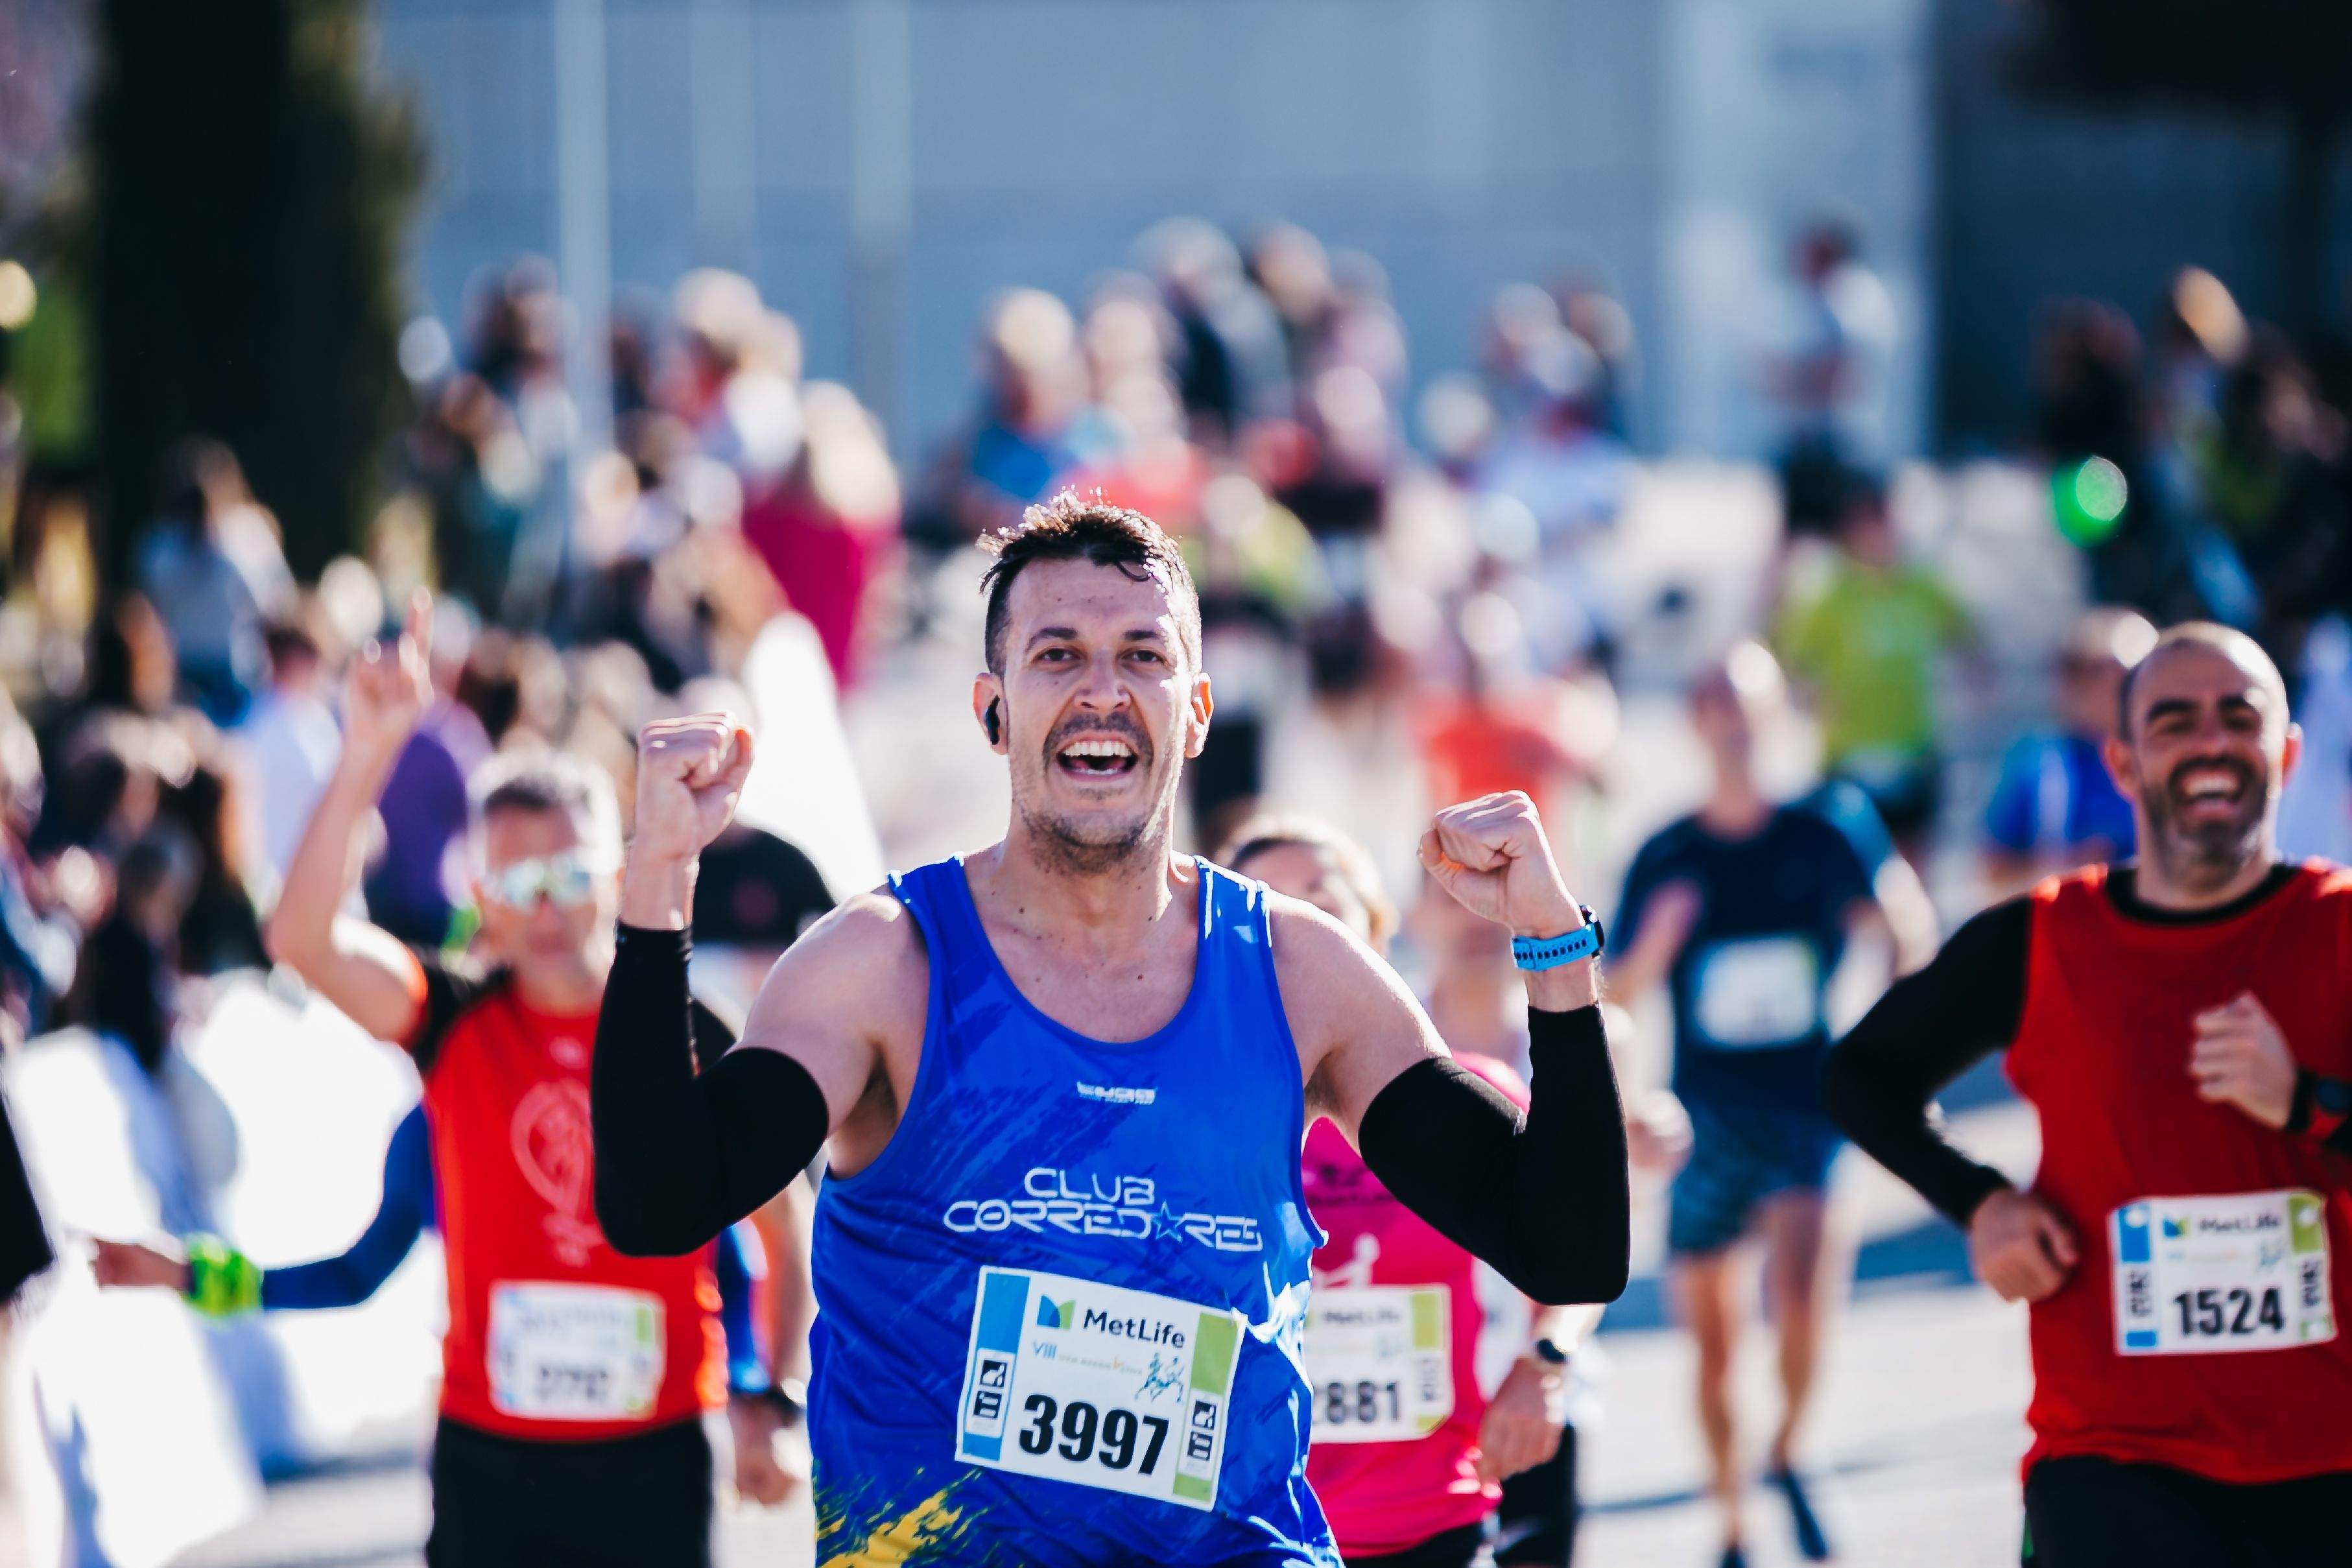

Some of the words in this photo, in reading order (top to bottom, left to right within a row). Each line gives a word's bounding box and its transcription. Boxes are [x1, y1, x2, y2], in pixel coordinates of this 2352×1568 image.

[1024, 1167, 1155, 1206] CLUB
[1082, 1307, 1186, 1349] MetLife
[2172, 1286, 2285, 1336] 1524
[1032, 1340, 1058, 1360] VIII
[1313, 1380, 1401, 1425] 881
[1018, 1394, 1170, 1475] 3997
